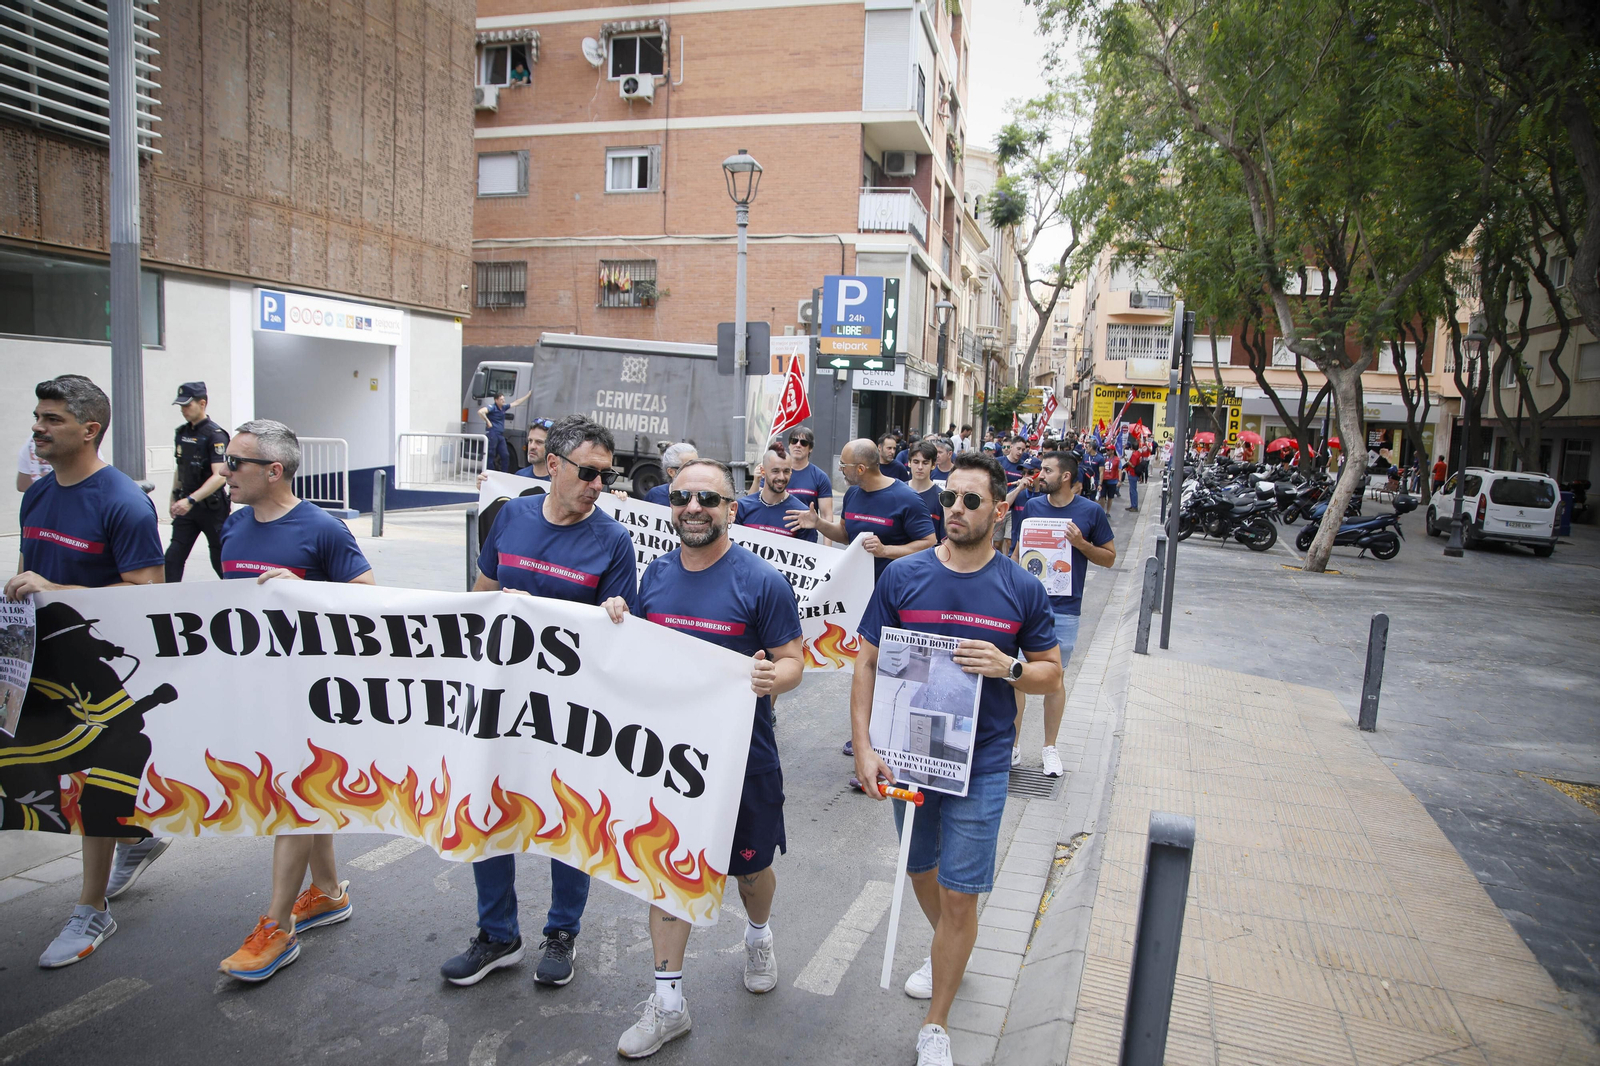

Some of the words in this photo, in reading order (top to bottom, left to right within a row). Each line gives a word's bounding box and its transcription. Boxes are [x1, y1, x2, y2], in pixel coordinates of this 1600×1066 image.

[263, 296, 278, 322] P
[837, 279, 868, 322] P
[848, 313, 865, 323] 24h
[836, 325, 862, 336] LIBRE
[832, 341, 868, 352] telpark
[596, 389, 668, 413] CERVEZAS
[1095, 387, 1131, 400] Compra
[1135, 389, 1161, 400] Venta
[590, 410, 669, 435] ALHAMBRA
[615, 508, 649, 528] LAS
[519, 559, 549, 571] DIGNIDAD
[550, 566, 585, 581] BOMBEROS
[9, 606, 25, 615] LOS
[665, 617, 695, 626] DIGNIDAD
[695, 621, 731, 632] BOMBEROS
[941, 613, 974, 623] DIGNIDAD
[974, 617, 1011, 630] BOMBEROS
[147, 607, 582, 678] BOMBEROS
[885, 633, 927, 646] DIGNIDAD
[308, 676, 709, 799] QUEMADOS
[873, 747, 887, 756] POR
[888, 750, 906, 760] UNAS
[907, 753, 962, 771] INSTALACIONES
[904, 761, 918, 770] DEN
[919, 765, 957, 778] VERGÜEZA
